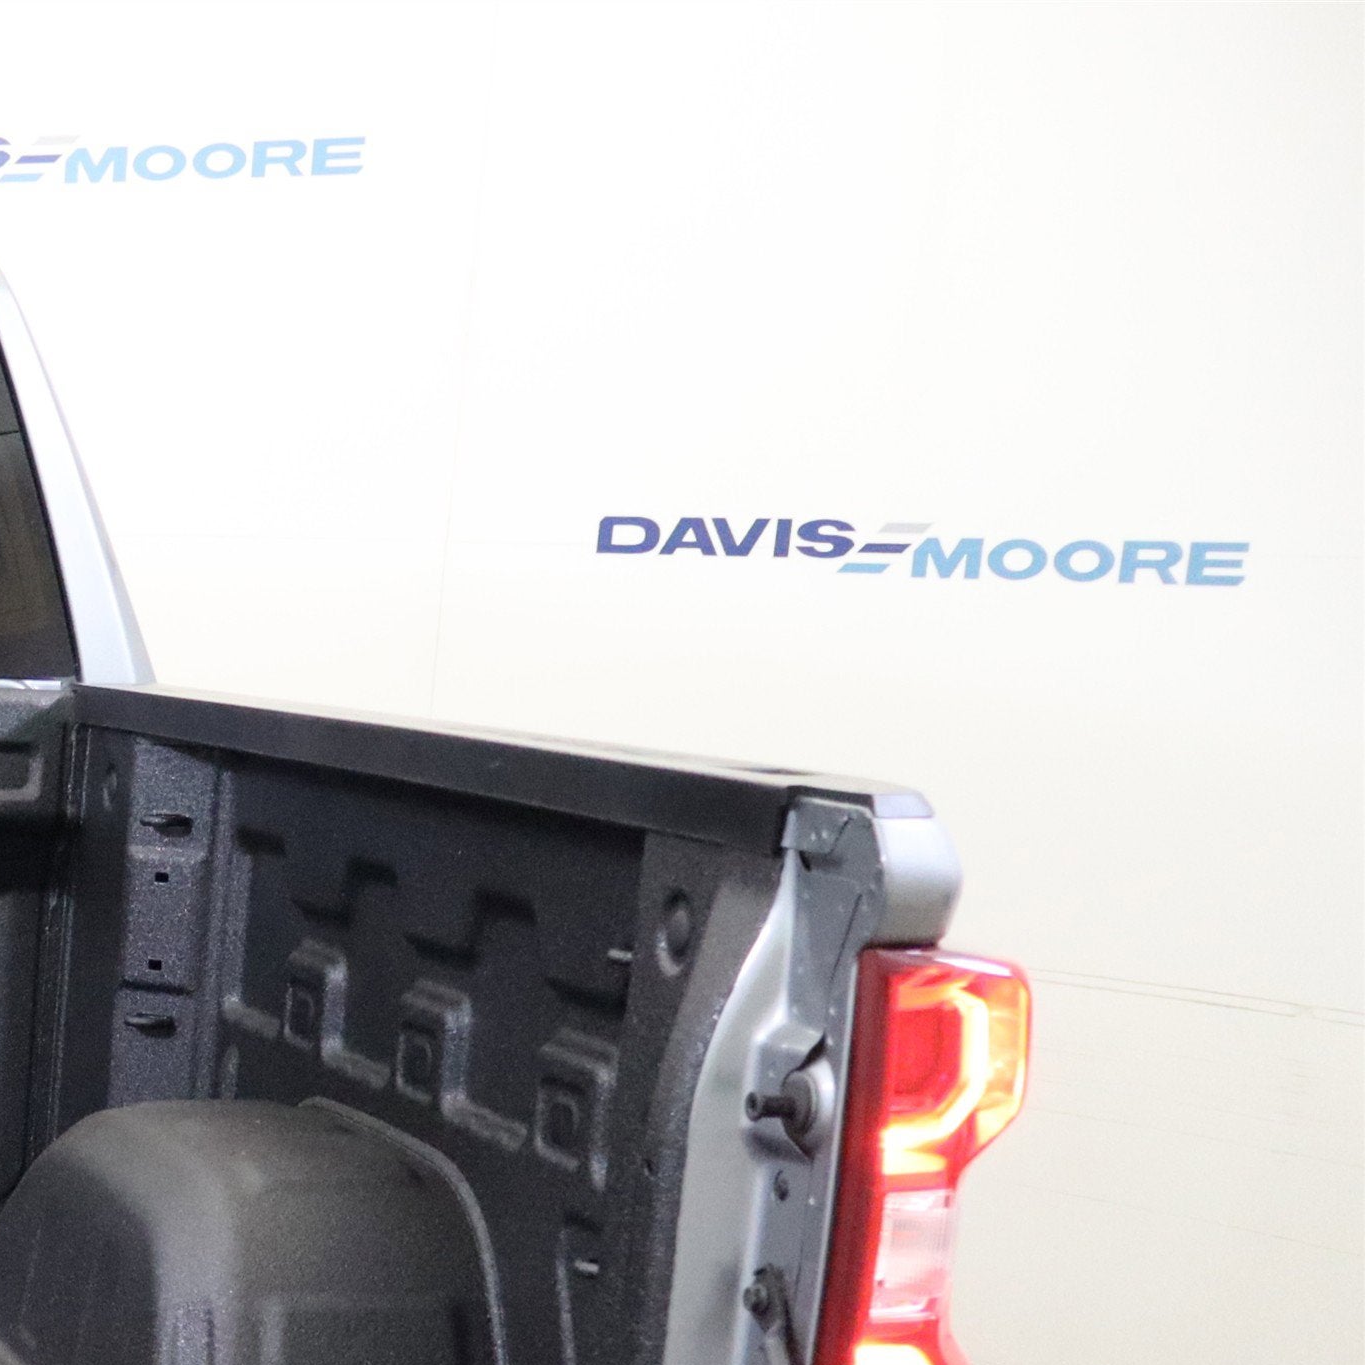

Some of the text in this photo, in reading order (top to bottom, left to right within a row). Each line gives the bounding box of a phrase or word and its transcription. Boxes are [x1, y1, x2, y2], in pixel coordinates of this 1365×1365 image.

[66, 136, 365, 184] MOORE
[596, 515, 1251, 587] DAVIS MOORE
